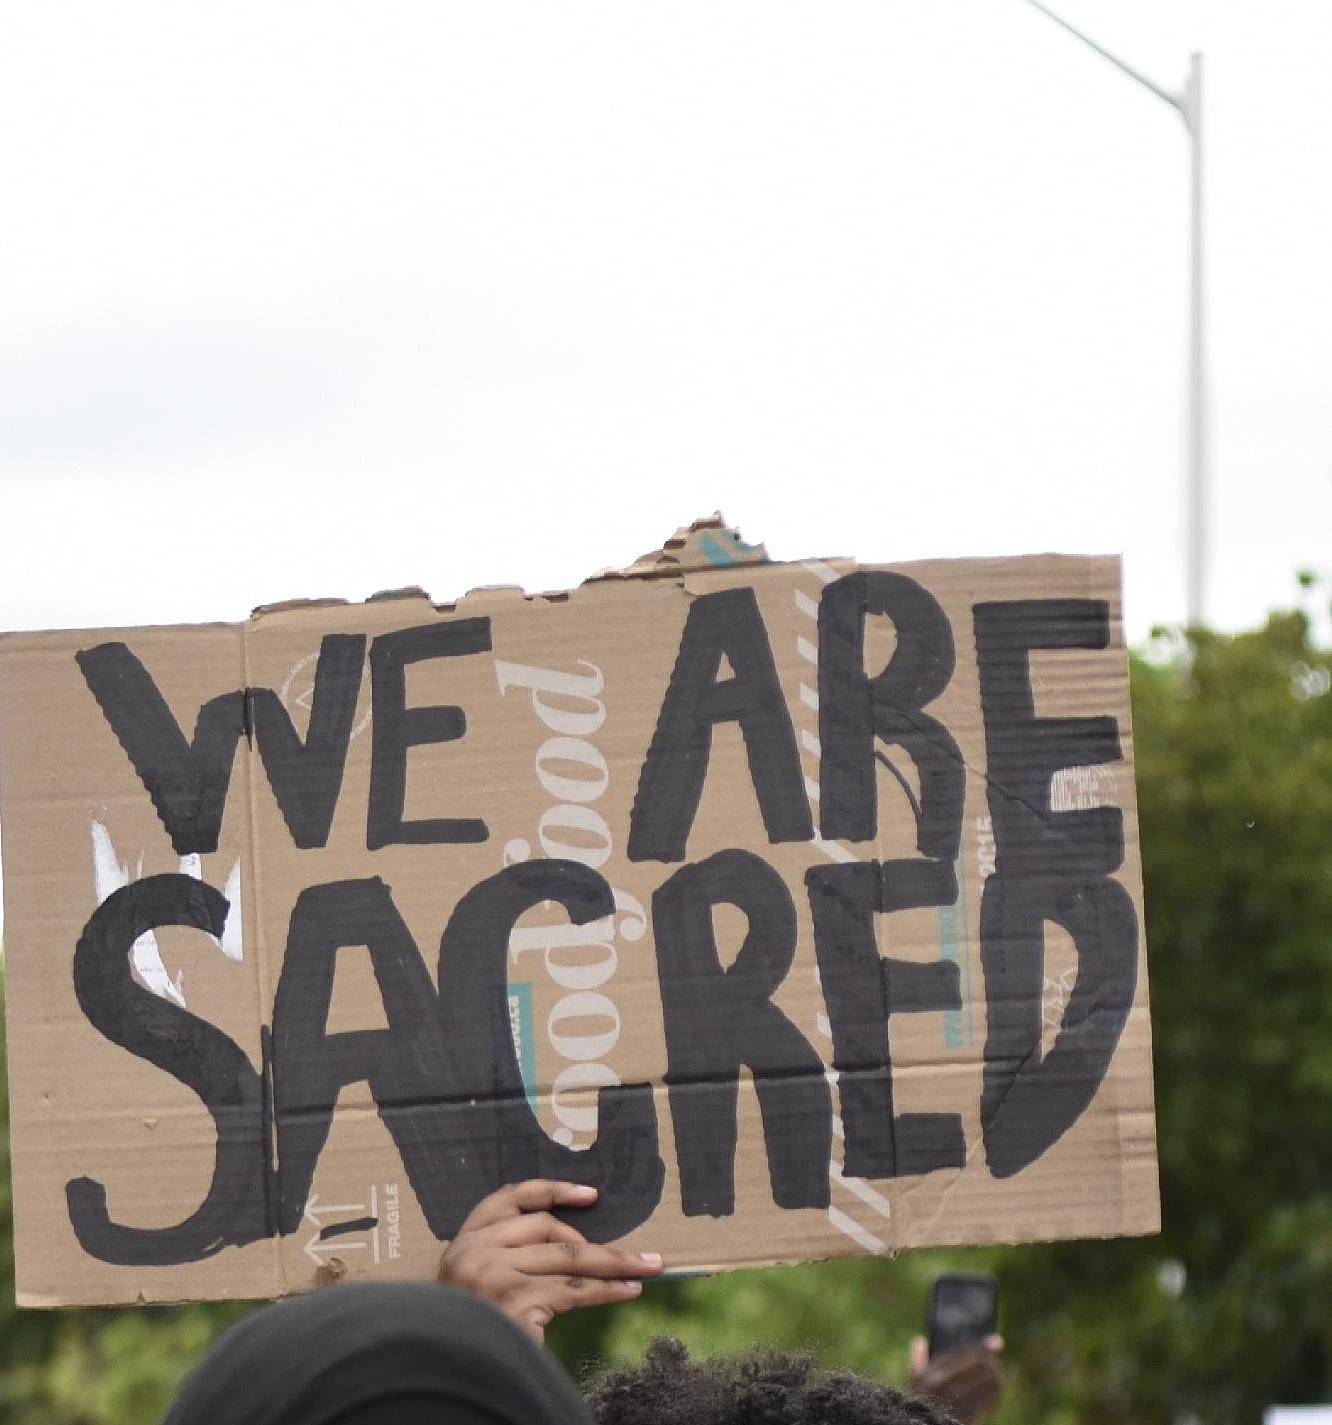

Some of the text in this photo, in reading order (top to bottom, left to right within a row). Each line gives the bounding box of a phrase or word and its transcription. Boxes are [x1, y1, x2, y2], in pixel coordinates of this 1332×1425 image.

[74, 570, 1126, 880] WE ARE
[494, 659, 647, 1149] oodfood
[65, 849, 1139, 1266] SACRED
[385, 1184, 401, 1259] FRAGILE
